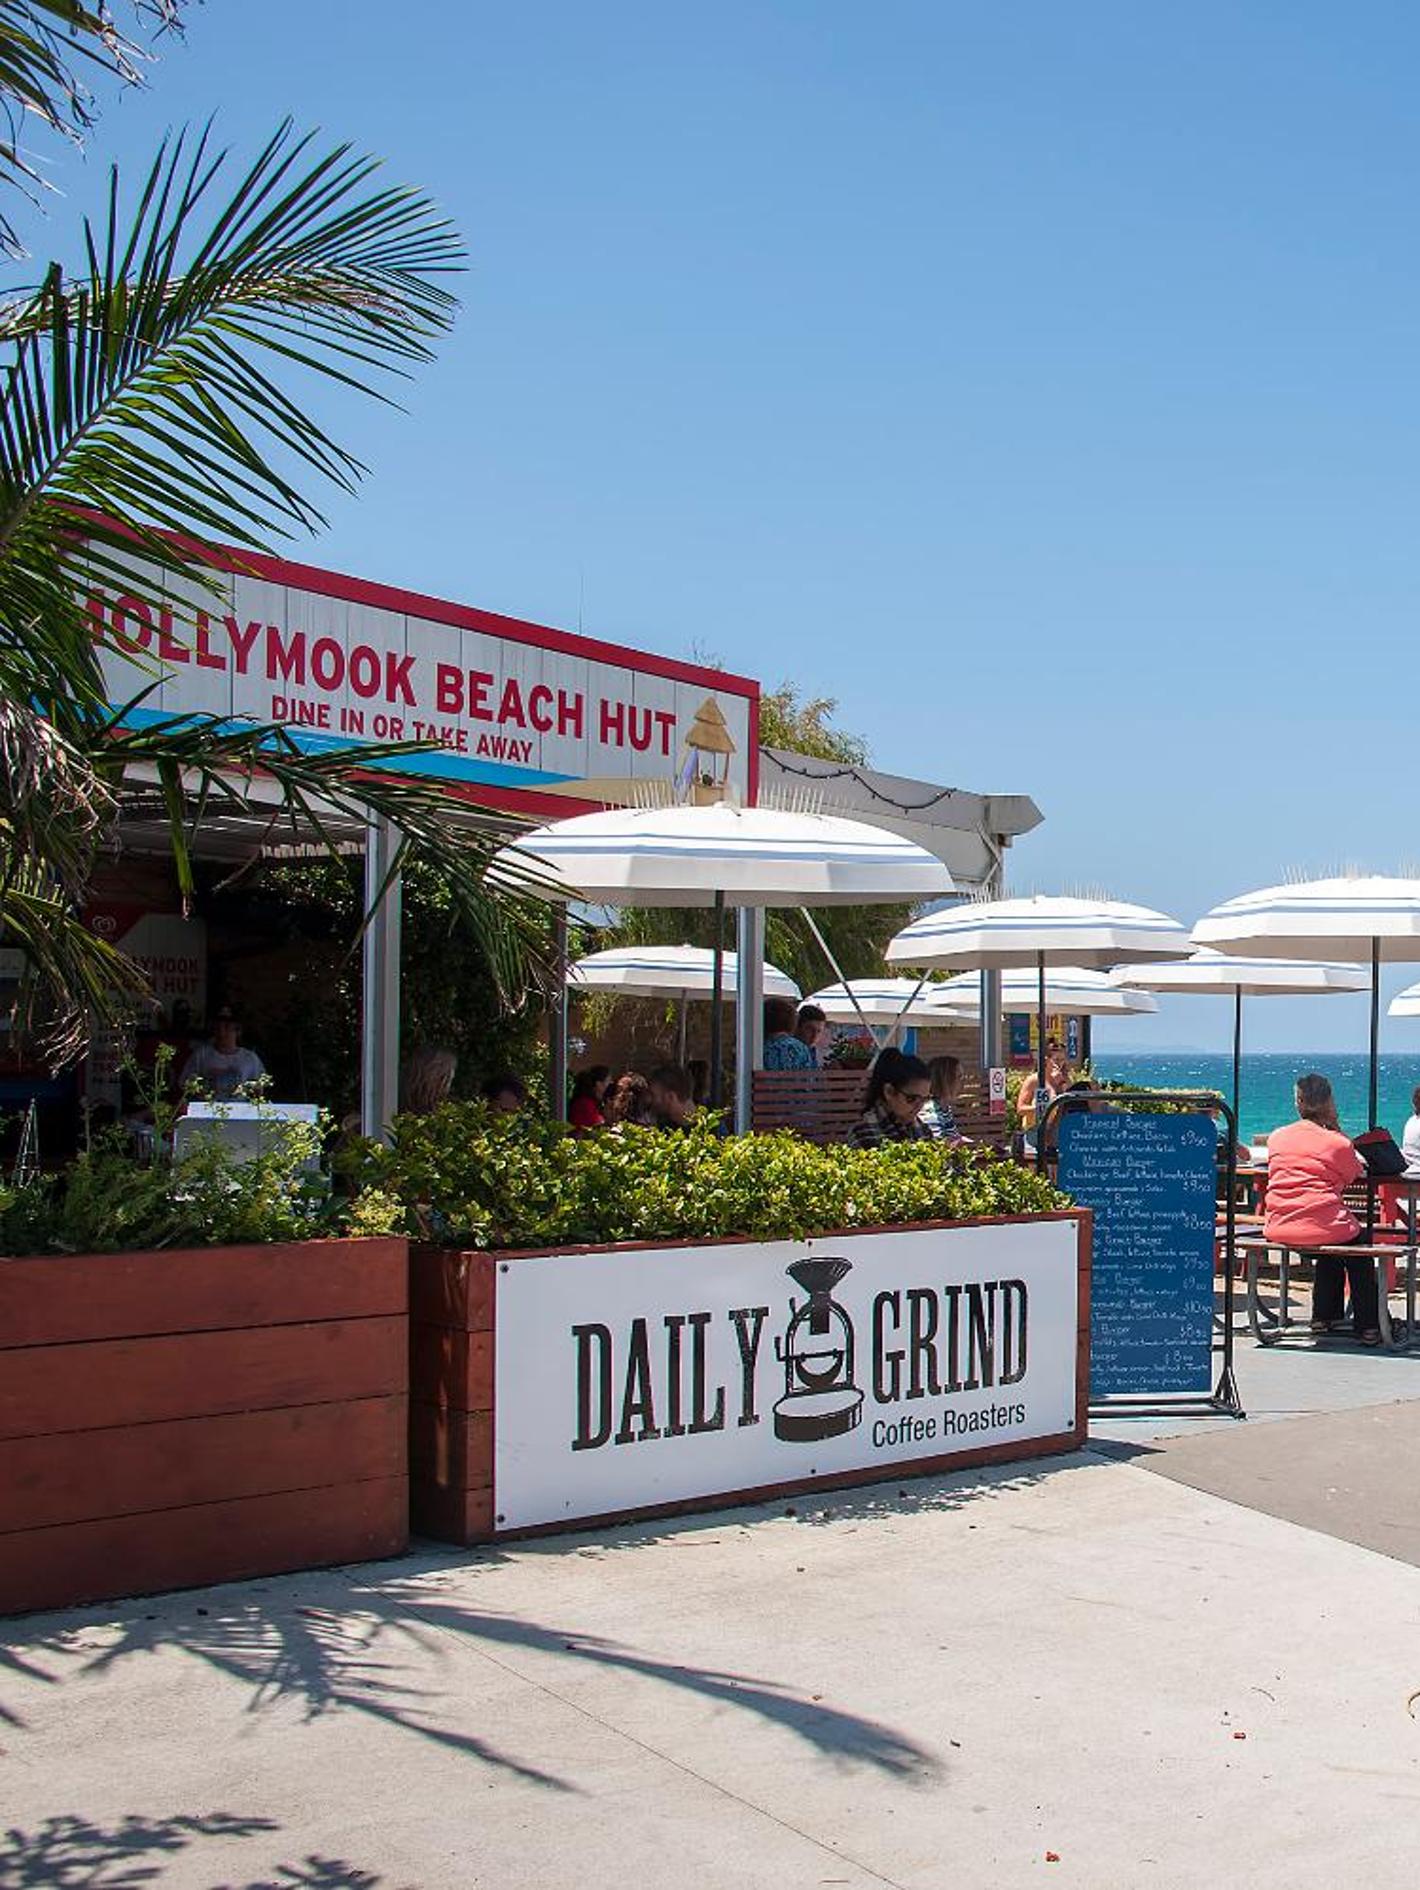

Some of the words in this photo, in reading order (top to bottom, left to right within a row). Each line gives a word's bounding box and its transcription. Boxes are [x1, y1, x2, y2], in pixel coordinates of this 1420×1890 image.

[272, 694, 331, 728] DINE
[340, 707, 365, 733] IN
[373, 715, 404, 742] OR
[412, 720, 469, 752] TAKE
[477, 733, 534, 763] AWAY
[436, 662, 583, 738] BEACH
[599, 698, 677, 756] HUT
[571, 1306, 770, 1452] DAILY
[872, 1278, 1029, 1404] GRIND
[872, 1413, 938, 1449] Coffee
[943, 1403, 1026, 1438] Roasters
